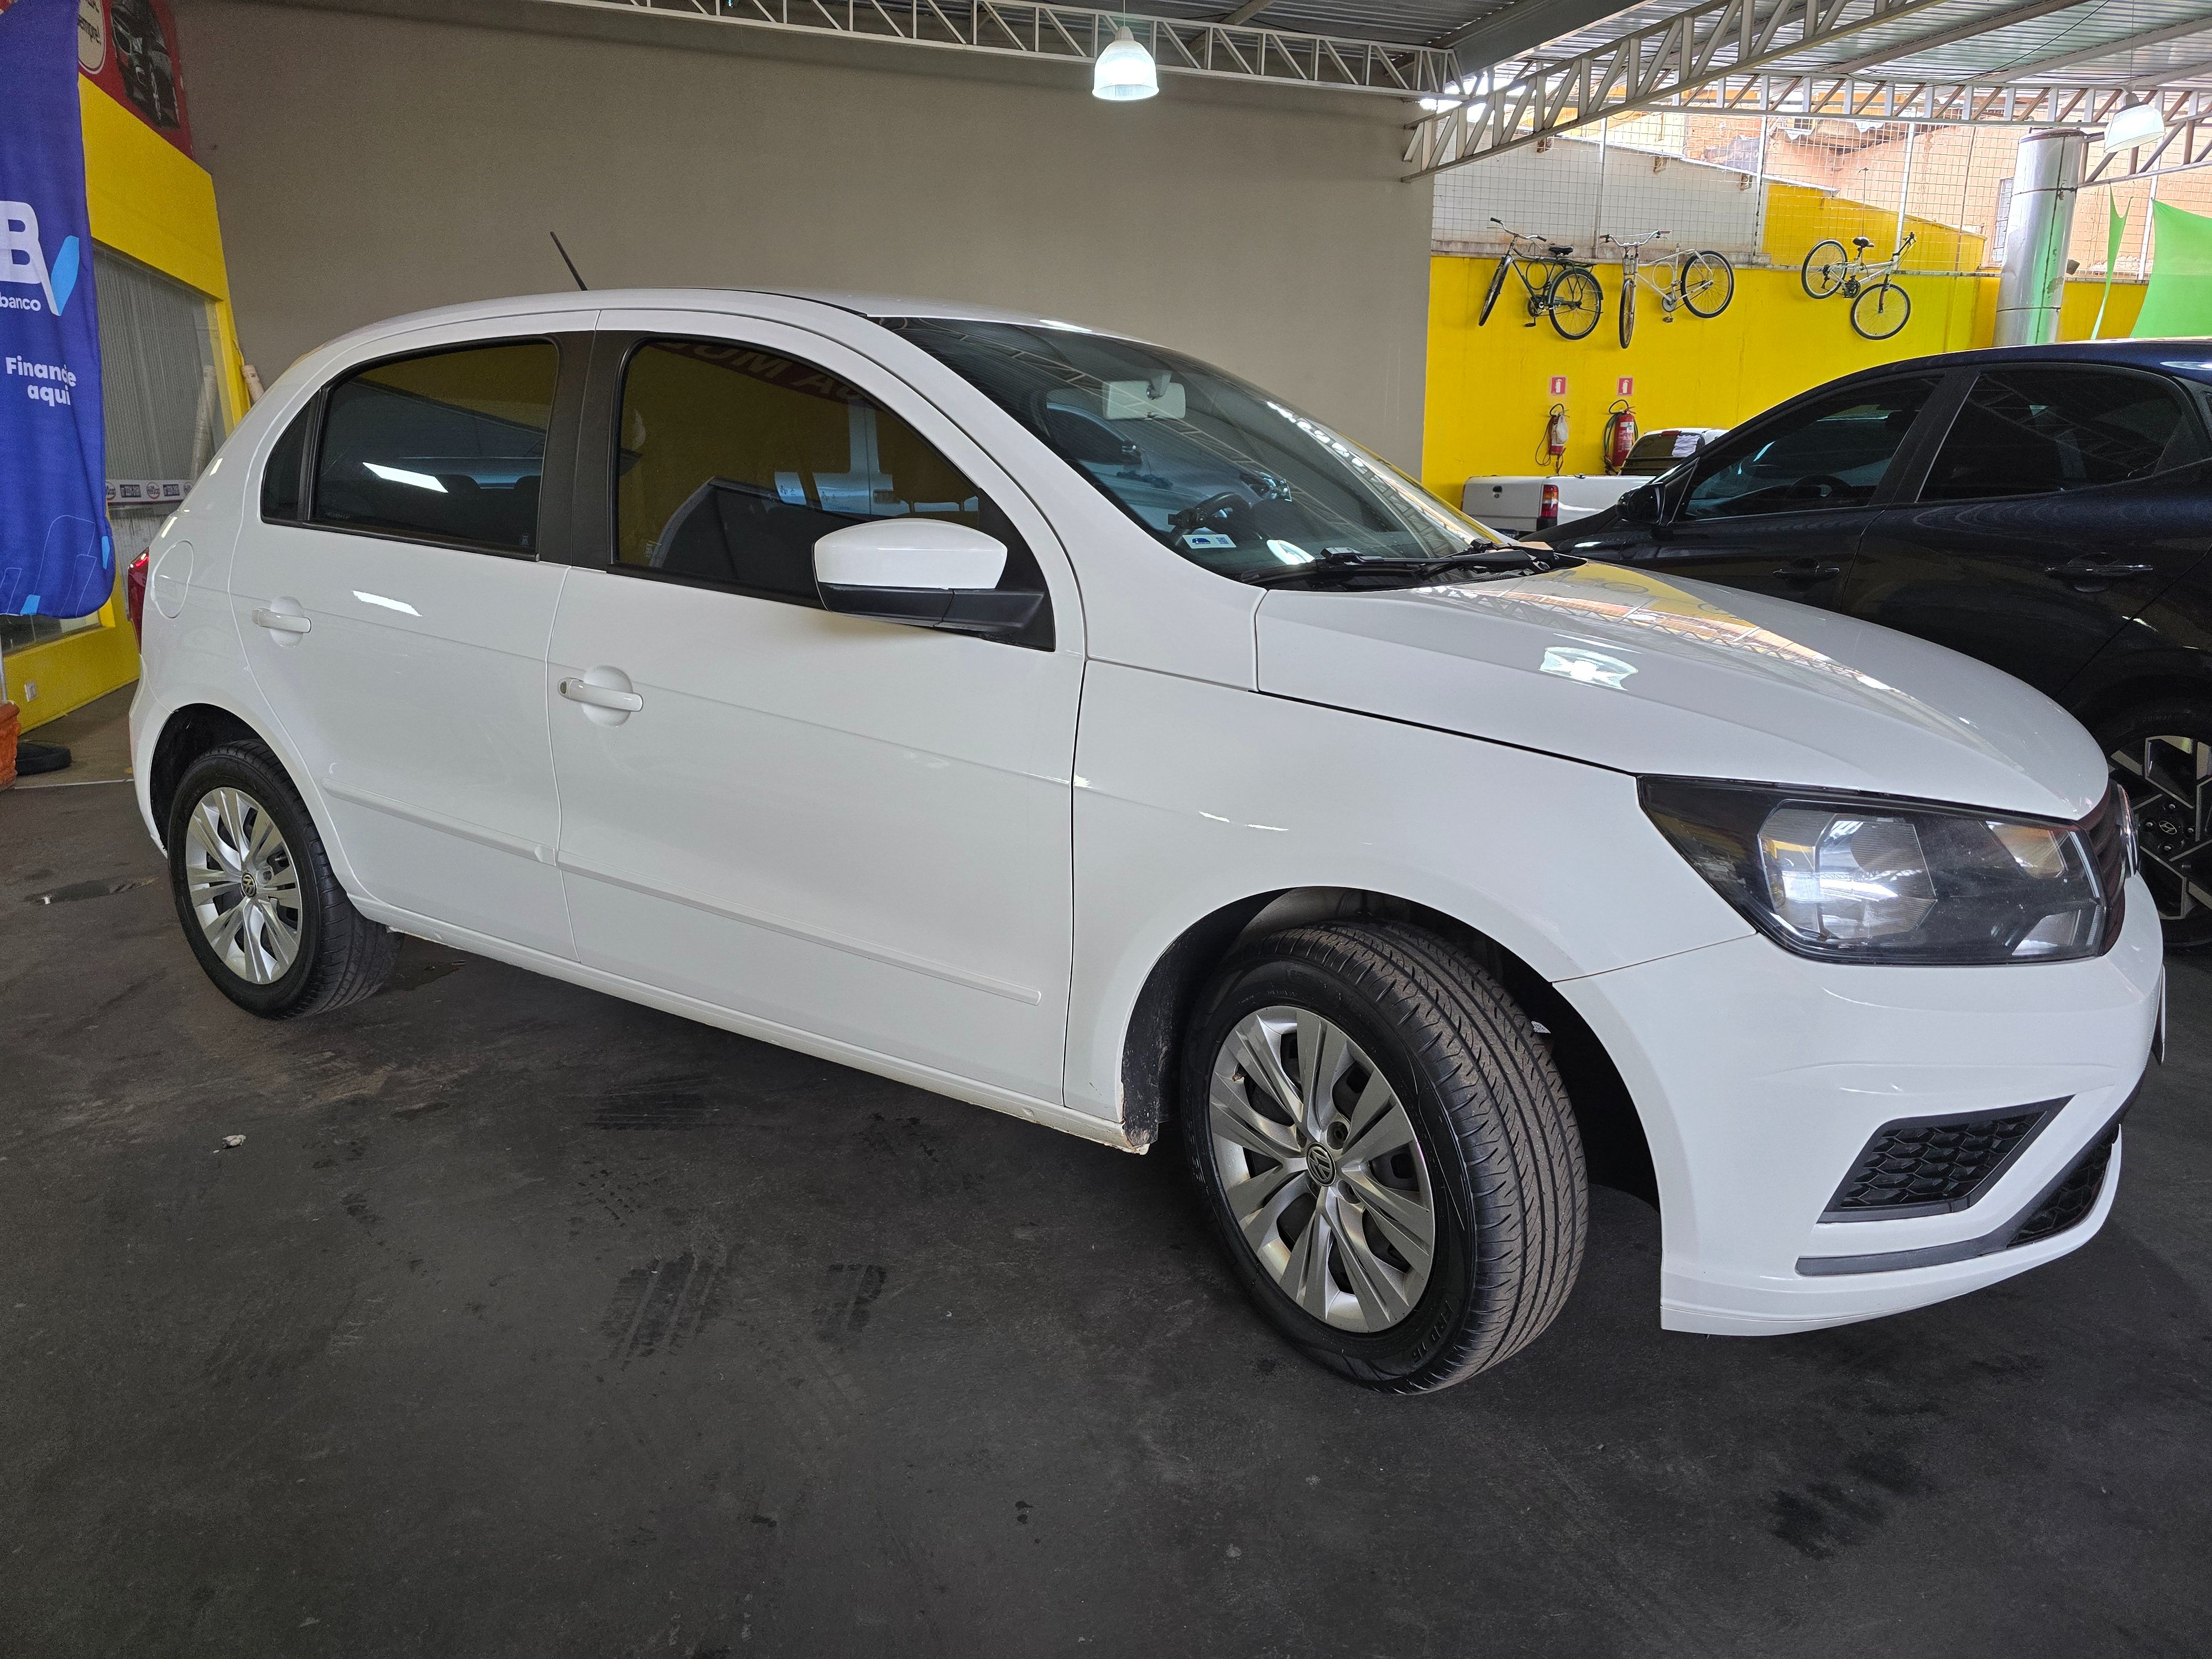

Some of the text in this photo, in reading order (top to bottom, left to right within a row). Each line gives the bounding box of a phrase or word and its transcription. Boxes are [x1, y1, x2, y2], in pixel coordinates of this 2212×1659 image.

[0, 292, 41, 311] banco
[6, 355, 76, 387] Financie
[27, 384, 71, 406] aqui
